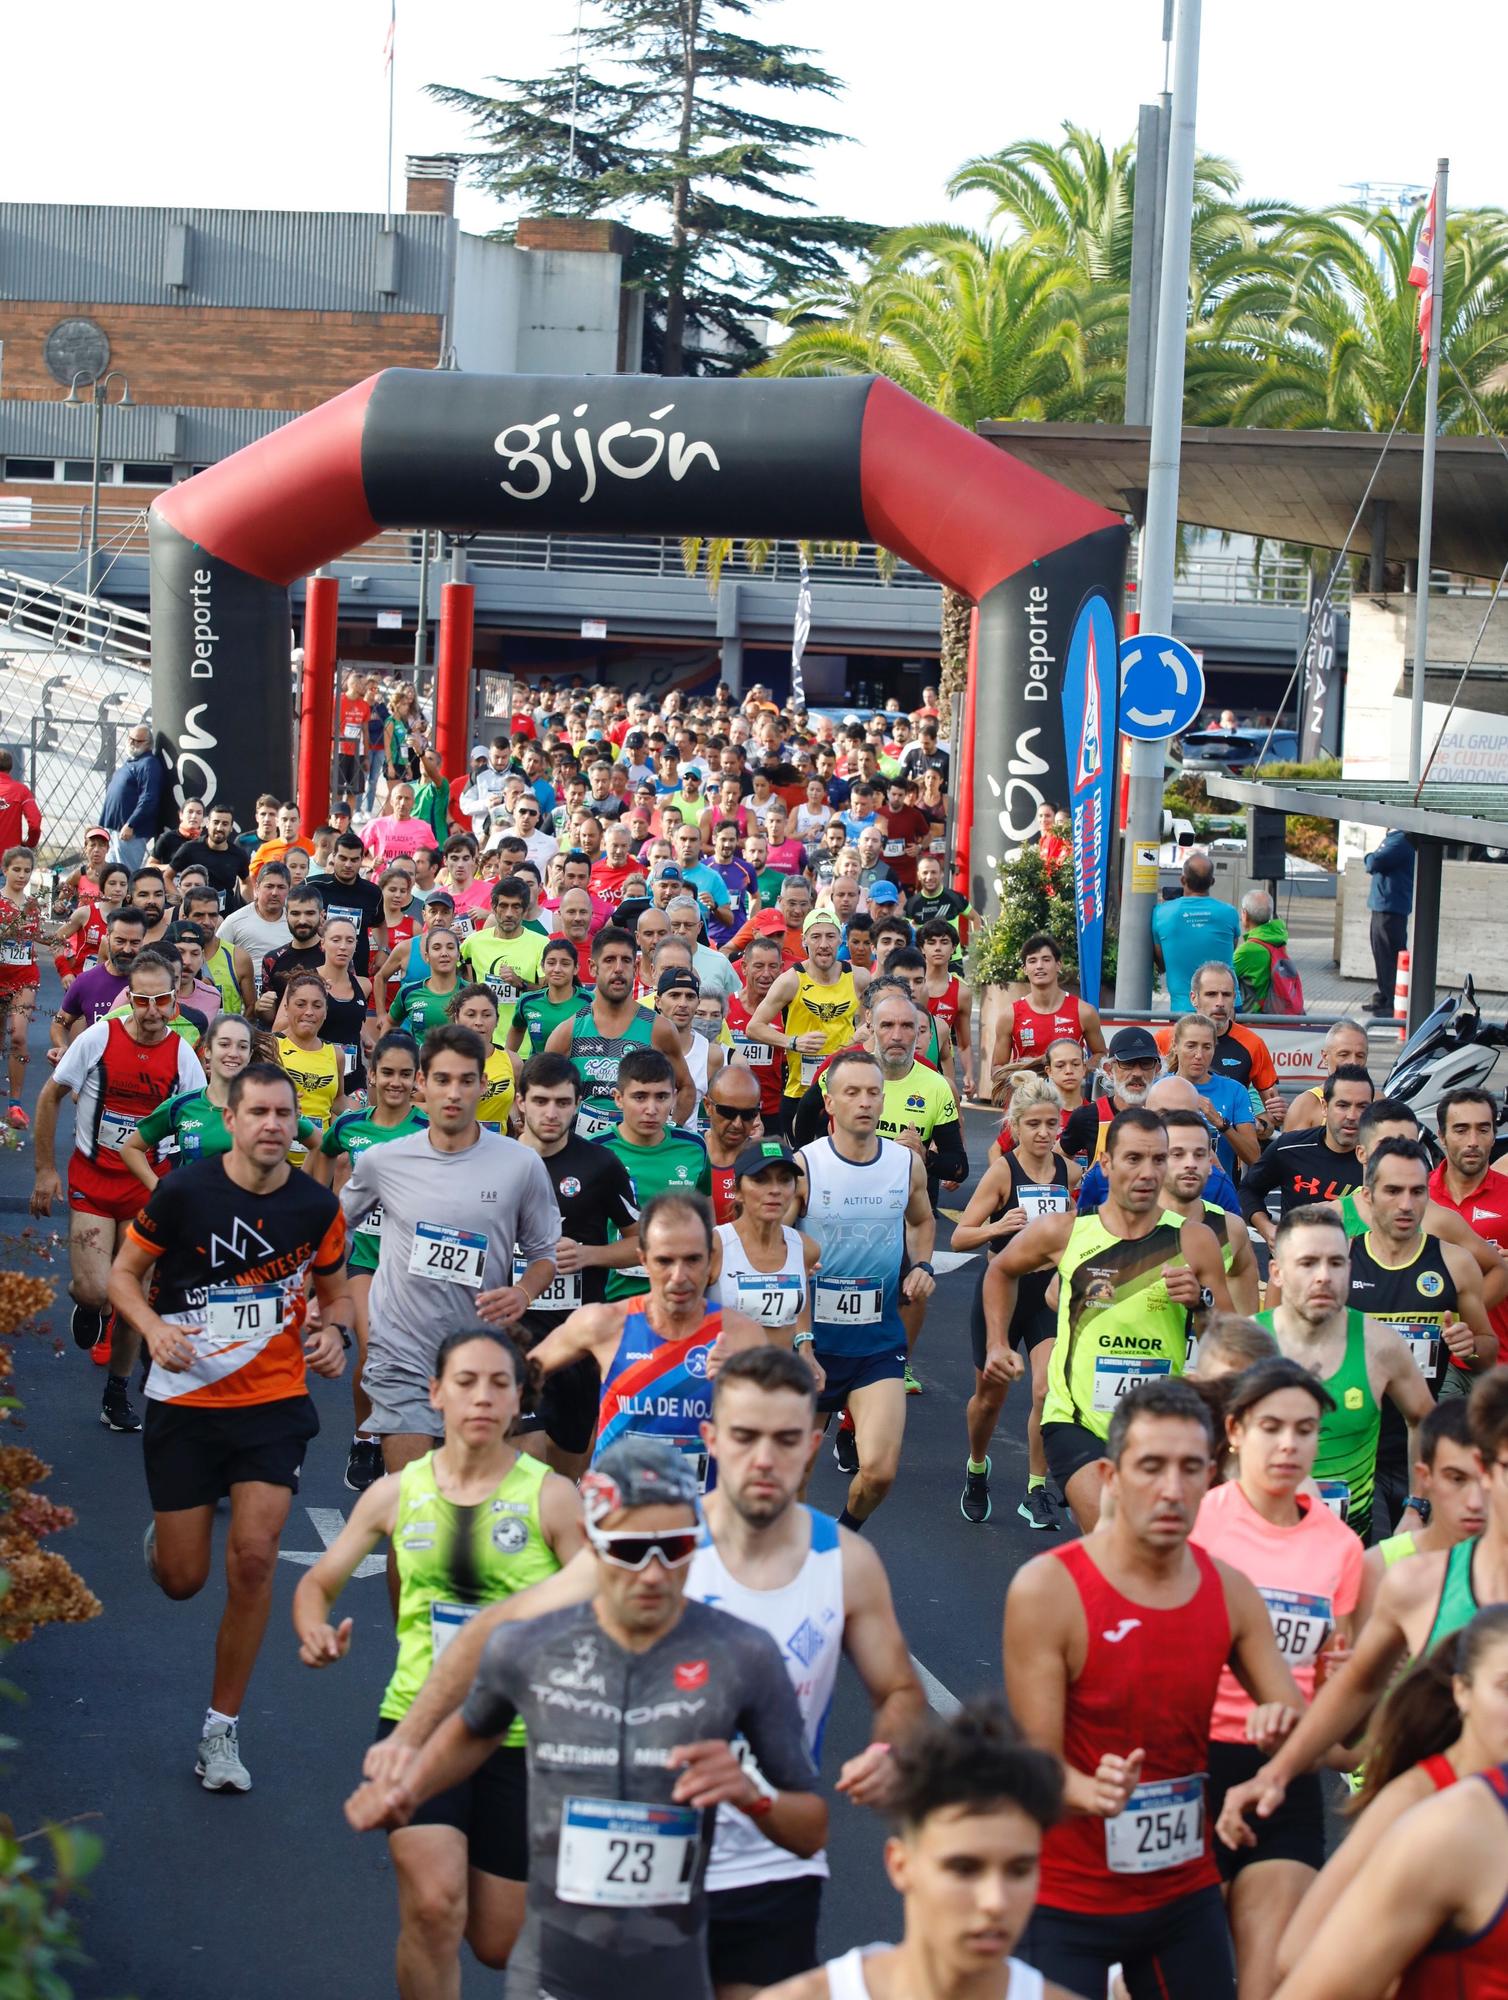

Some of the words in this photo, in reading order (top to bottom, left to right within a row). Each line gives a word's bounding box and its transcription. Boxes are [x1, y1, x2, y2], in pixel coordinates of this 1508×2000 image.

[494, 403, 720, 503] gijón
[190, 569, 219, 678] Deporte
[1024, 586, 1055, 701] Deporte
[1468, 734, 1508, 750] GRUP
[1453, 752, 1508, 766] CULTUR
[1428, 766, 1507, 783] COVADONG
[743, 1045, 762, 1059] 491
[349, 1136, 372, 1147] gijón
[481, 1191, 497, 1200] FAR
[843, 1196, 883, 1206] ALTITUD
[427, 1242, 469, 1273] 282
[761, 1292, 784, 1316] 27
[837, 1294, 861, 1314] 40
[234, 1304, 260, 1330] 70
[1098, 1335, 1162, 1350] GANOR
[616, 1394, 654, 1416] VILLA
[657, 1397, 679, 1417] DE
[683, 1399, 714, 1419] NOJ
[1136, 1809, 1187, 1854] 254
[606, 1840, 655, 1884] 23
